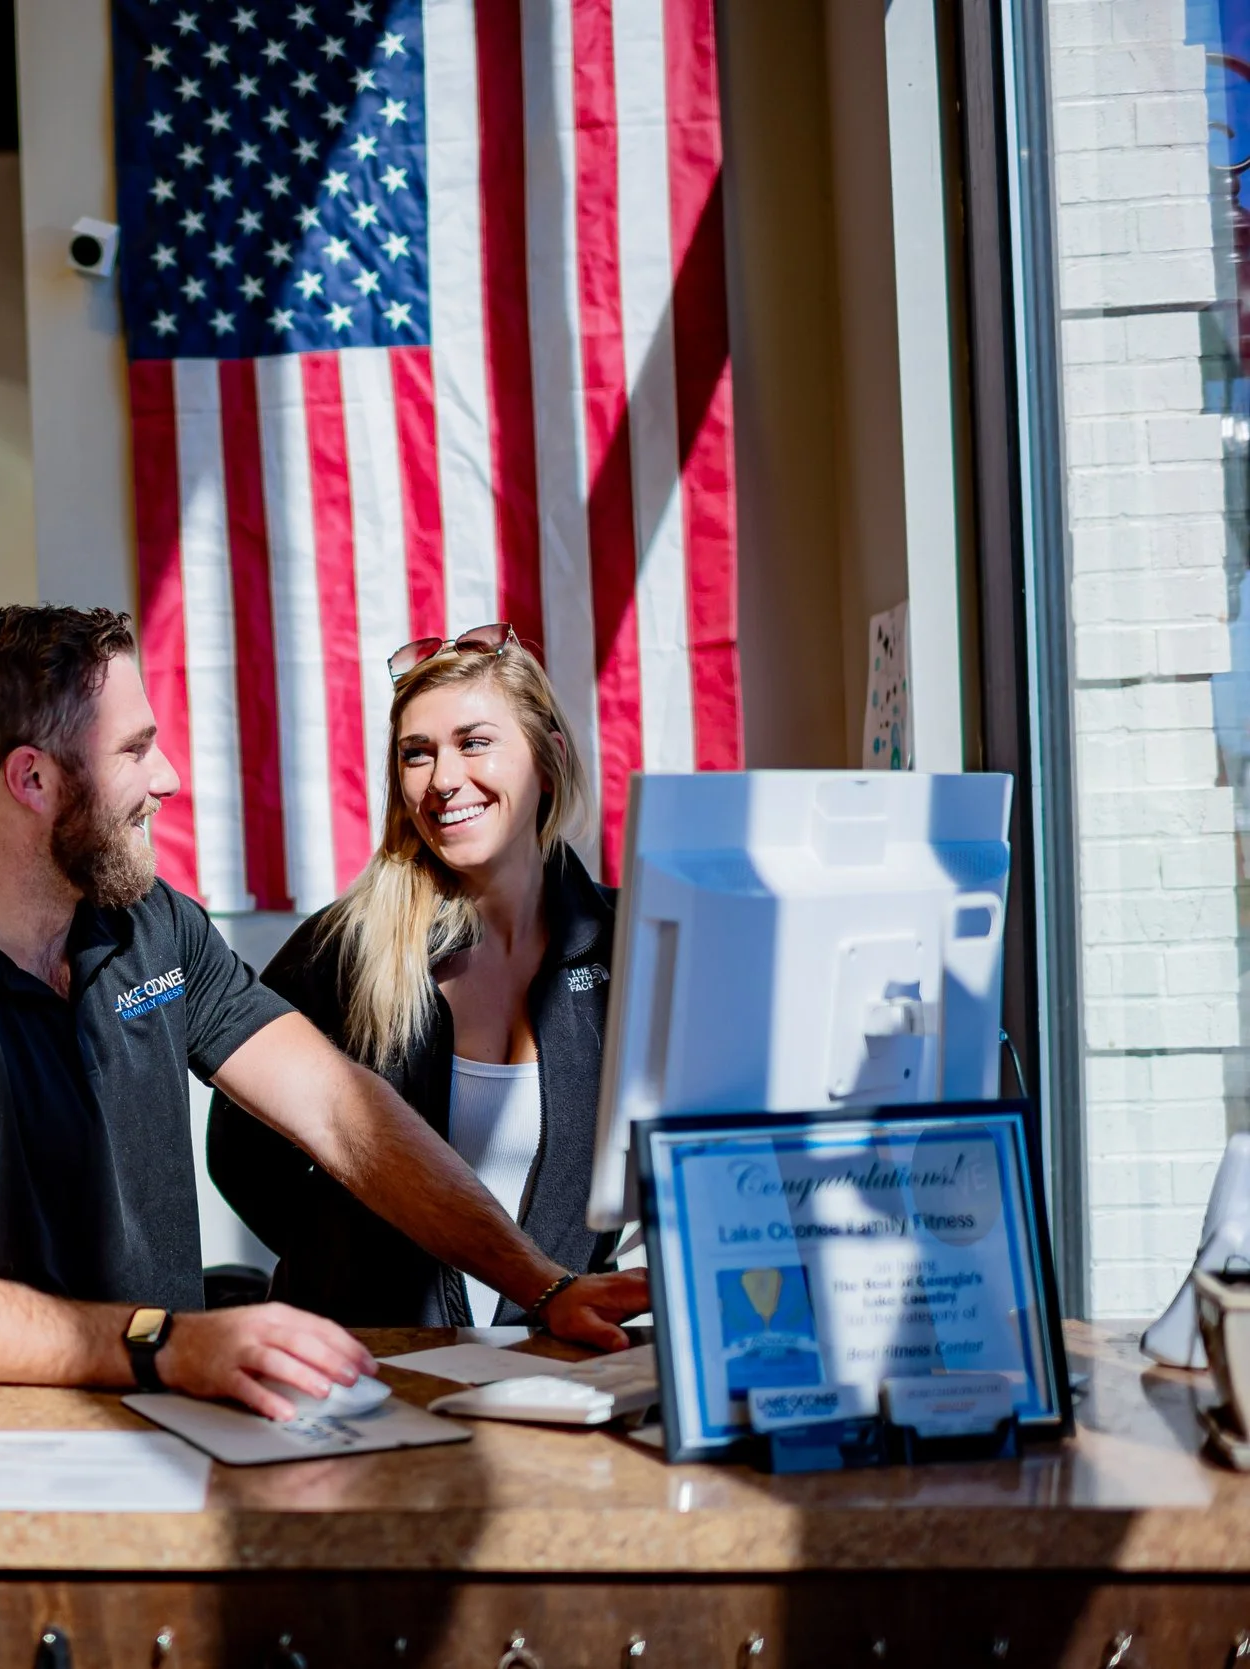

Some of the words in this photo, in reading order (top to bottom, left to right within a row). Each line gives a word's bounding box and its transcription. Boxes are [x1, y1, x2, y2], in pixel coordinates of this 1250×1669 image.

[567, 974, 593, 986] ORTH
[571, 967, 590, 977] THE
[144, 967, 185, 997] OONEE
[570, 981, 594, 993] FACE
[121, 998, 157, 1020] FAMILY
[718, 1223, 761, 1244] Lake
[767, 1219, 841, 1241] Oconee
[846, 1213, 907, 1238] Family
[912, 1211, 975, 1231] Fitness
[962, 1303, 977, 1321] of
[935, 1339, 984, 1356] Center
